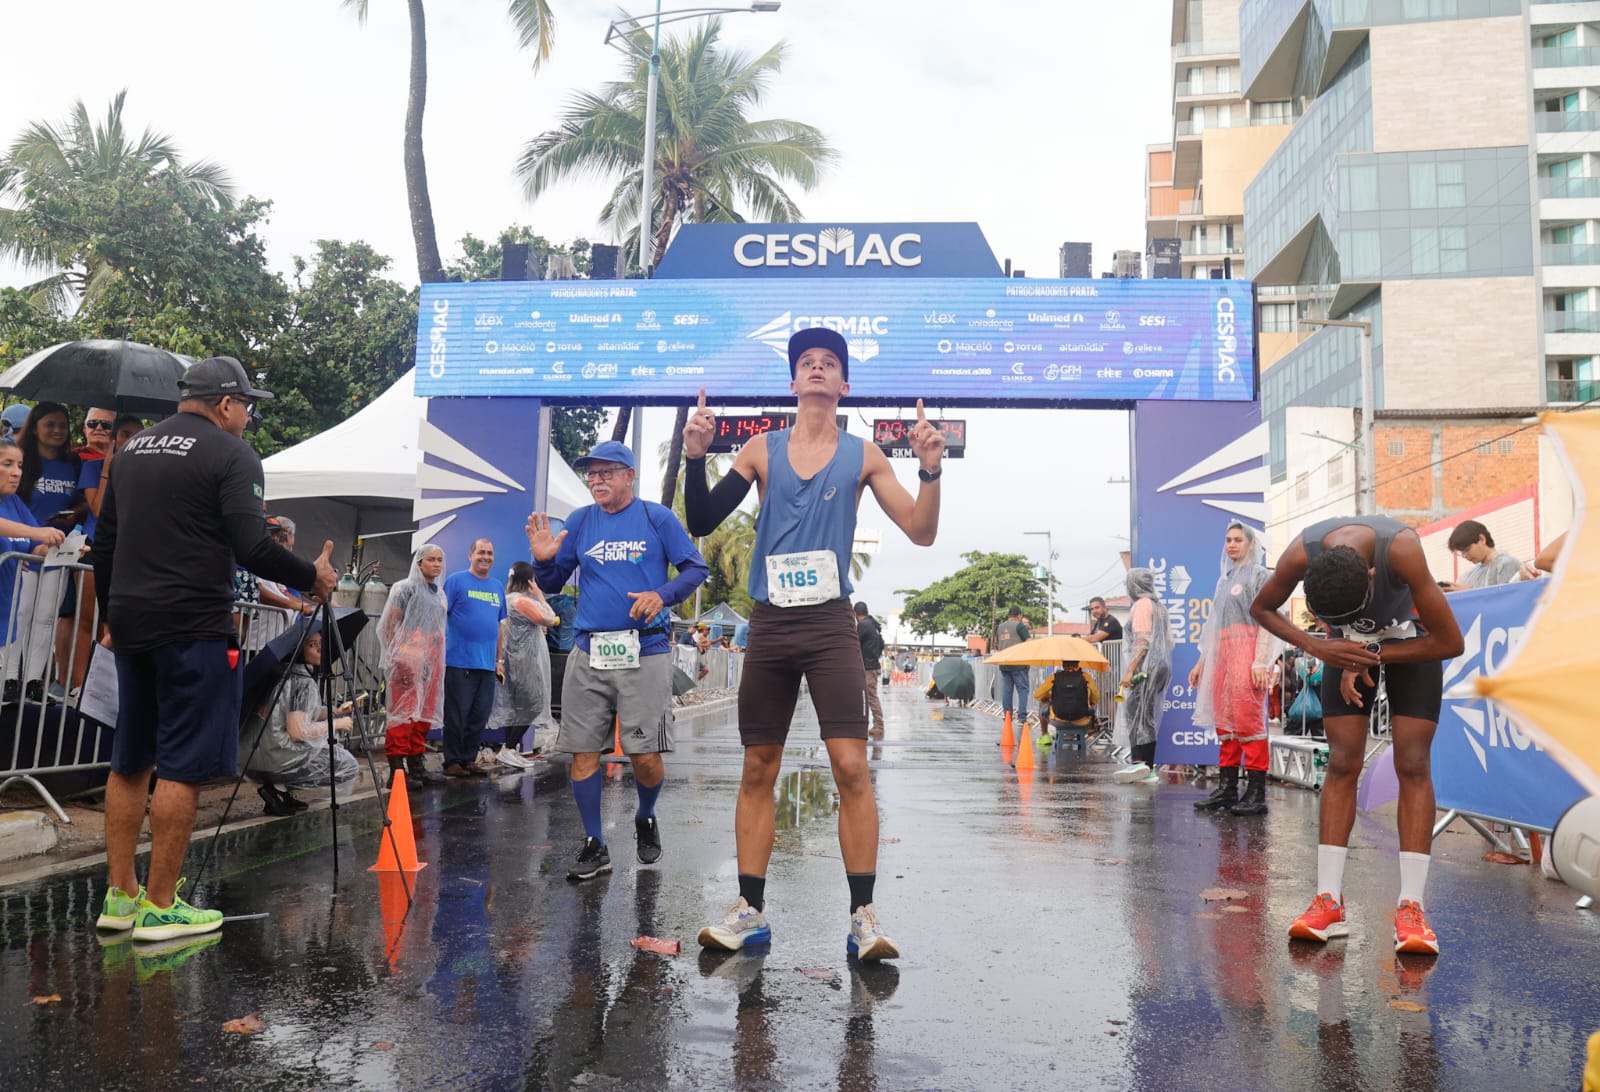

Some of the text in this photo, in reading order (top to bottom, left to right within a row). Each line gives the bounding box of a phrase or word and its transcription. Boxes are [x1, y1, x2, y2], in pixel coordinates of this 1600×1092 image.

[733, 228, 921, 267] CESMAC
[1070, 286, 1098, 297] PRATA:
[569, 313, 609, 323] Unimed
[1028, 313, 1070, 323] Unimed
[429, 299, 449, 379] CESMAC
[1216, 297, 1236, 383] CESMAC
[955, 342, 993, 352] Maceió
[124, 435, 197, 452] MYLAPS
[892, 448, 912, 458] 5KM
[45, 485, 64, 494] RUN
[605, 541, 647, 551] CESMAC
[605, 551, 627, 561] RUN
[778, 569, 818, 588] 1185
[1168, 598, 1186, 644] RUN
[597, 643, 627, 656] 1010
[1172, 730, 1223, 746] CESM
